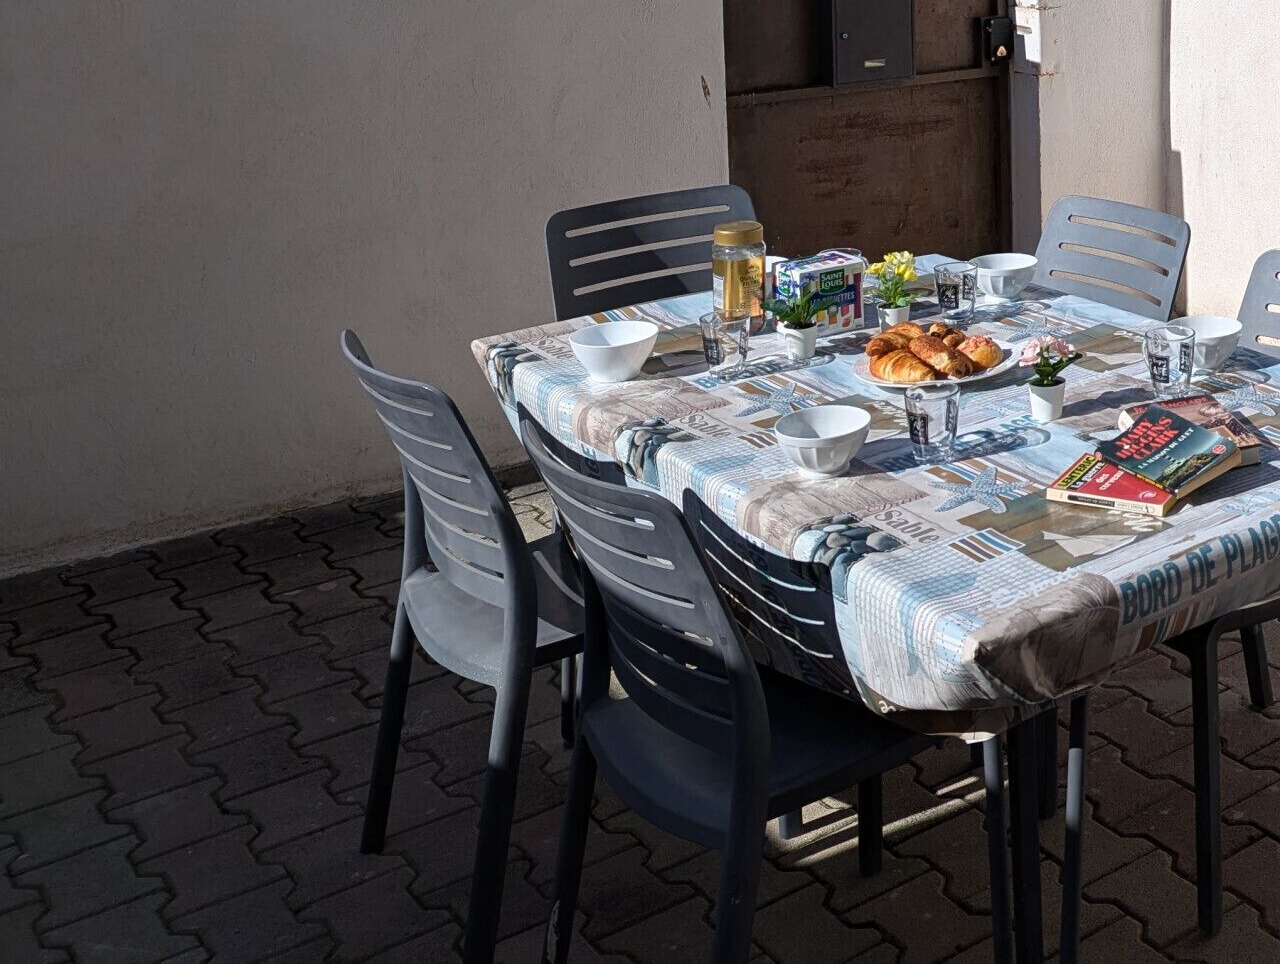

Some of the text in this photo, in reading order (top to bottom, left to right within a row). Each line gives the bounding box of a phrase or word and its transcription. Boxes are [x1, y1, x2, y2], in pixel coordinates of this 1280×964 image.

[820, 271, 844, 282] SAINT
[821, 279, 844, 289] LOUIS
[1115, 419, 1154, 446] MARY
[1115, 417, 1173, 459] HIGGINS
[1133, 430, 1181, 460] CLARK
[1061, 456, 1096, 487] LENTERIC
[875, 509, 941, 545] Sable
[1119, 560, 1182, 626] BORD
[1185, 544, 1218, 597] DE
